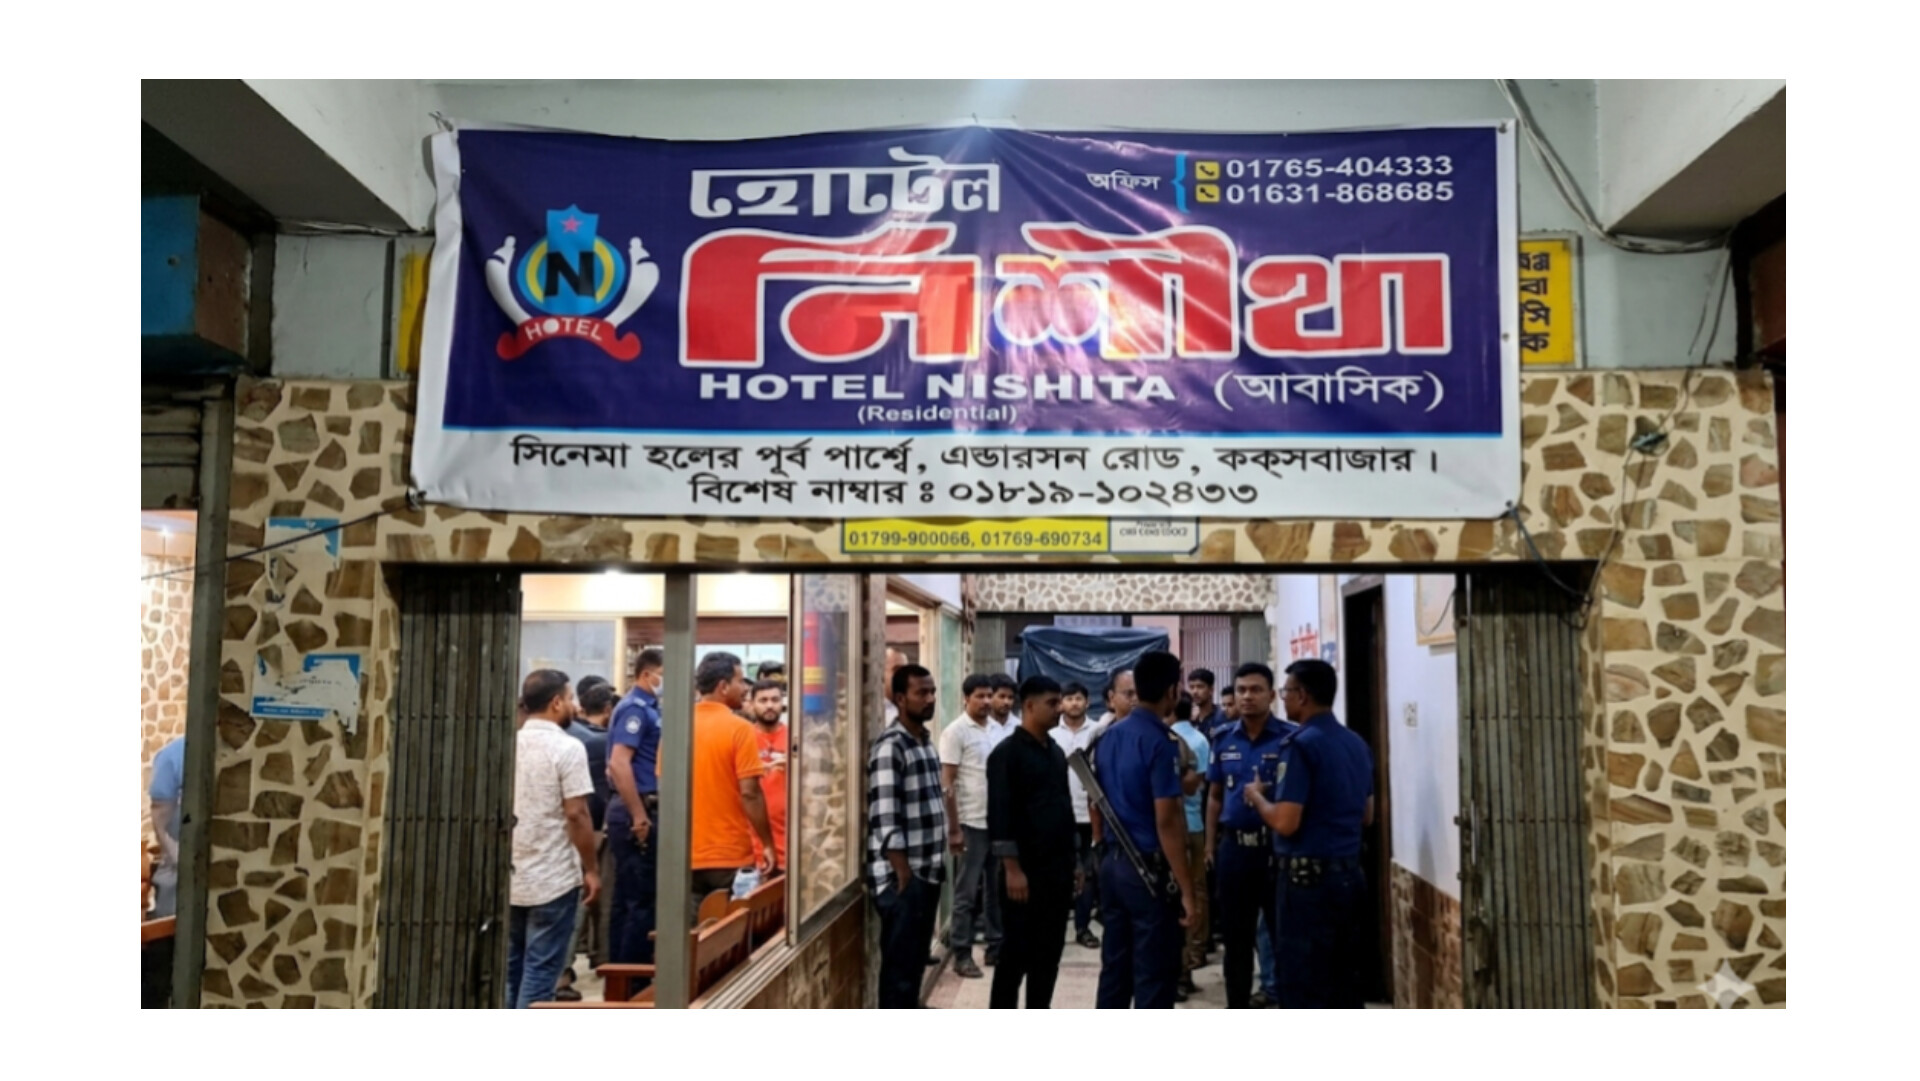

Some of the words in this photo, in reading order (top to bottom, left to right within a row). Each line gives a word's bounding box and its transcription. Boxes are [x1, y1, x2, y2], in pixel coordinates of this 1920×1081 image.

[1086, 169, 1160, 191] অফিস
[1226, 156, 1453, 178] 01765-404333
[690, 146, 1000, 218] হোটেল
[1226, 182, 1454, 203] 01631-868685
[543, 251, 597, 299] N
[679, 221, 1452, 368] নিশীথা
[525, 317, 602, 341] HOTEL
[700, 373, 904, 400] HOTEL
[926, 374, 1175, 400] NISHITA
[1214, 365, 1445, 411] (আবাসিক)
[857, 404, 1017, 424] (Residential)
[510, 434, 631, 468] সিনেমা
[643, 445, 743, 471] হলের
[755, 438, 812, 476] পূর্ব
[688, 474, 798, 504] বিশেষ
[809, 479, 907, 504] নাম্বার
[948, 480, 1259, 508] ০১৮১৯-১০২৪৩৩
[849, 531, 976, 548] 01799-900066,
[981, 531, 1103, 546] 01769-690734
